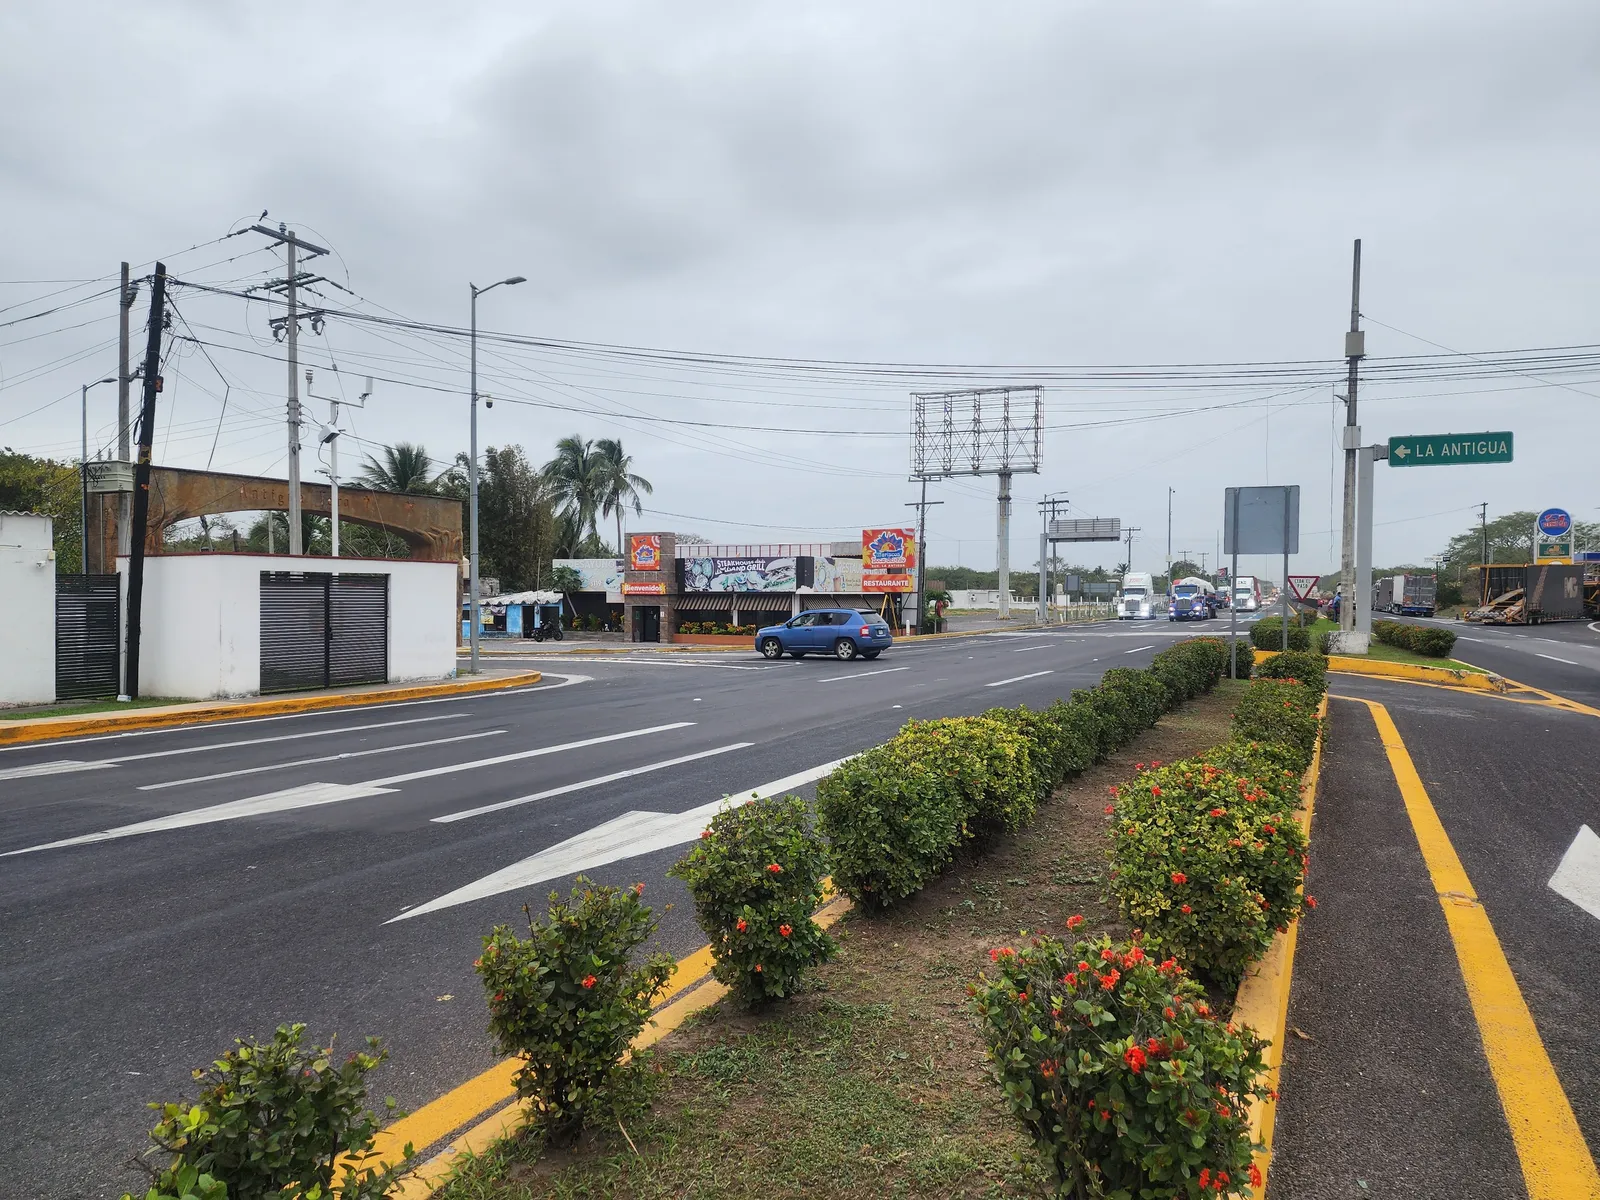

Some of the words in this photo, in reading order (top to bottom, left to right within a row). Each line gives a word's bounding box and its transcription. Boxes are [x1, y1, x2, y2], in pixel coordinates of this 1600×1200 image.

[1416, 444, 1434, 457] LA
[1441, 440, 1508, 457] ANTIGUA
[747, 563, 765, 571] GRILL
